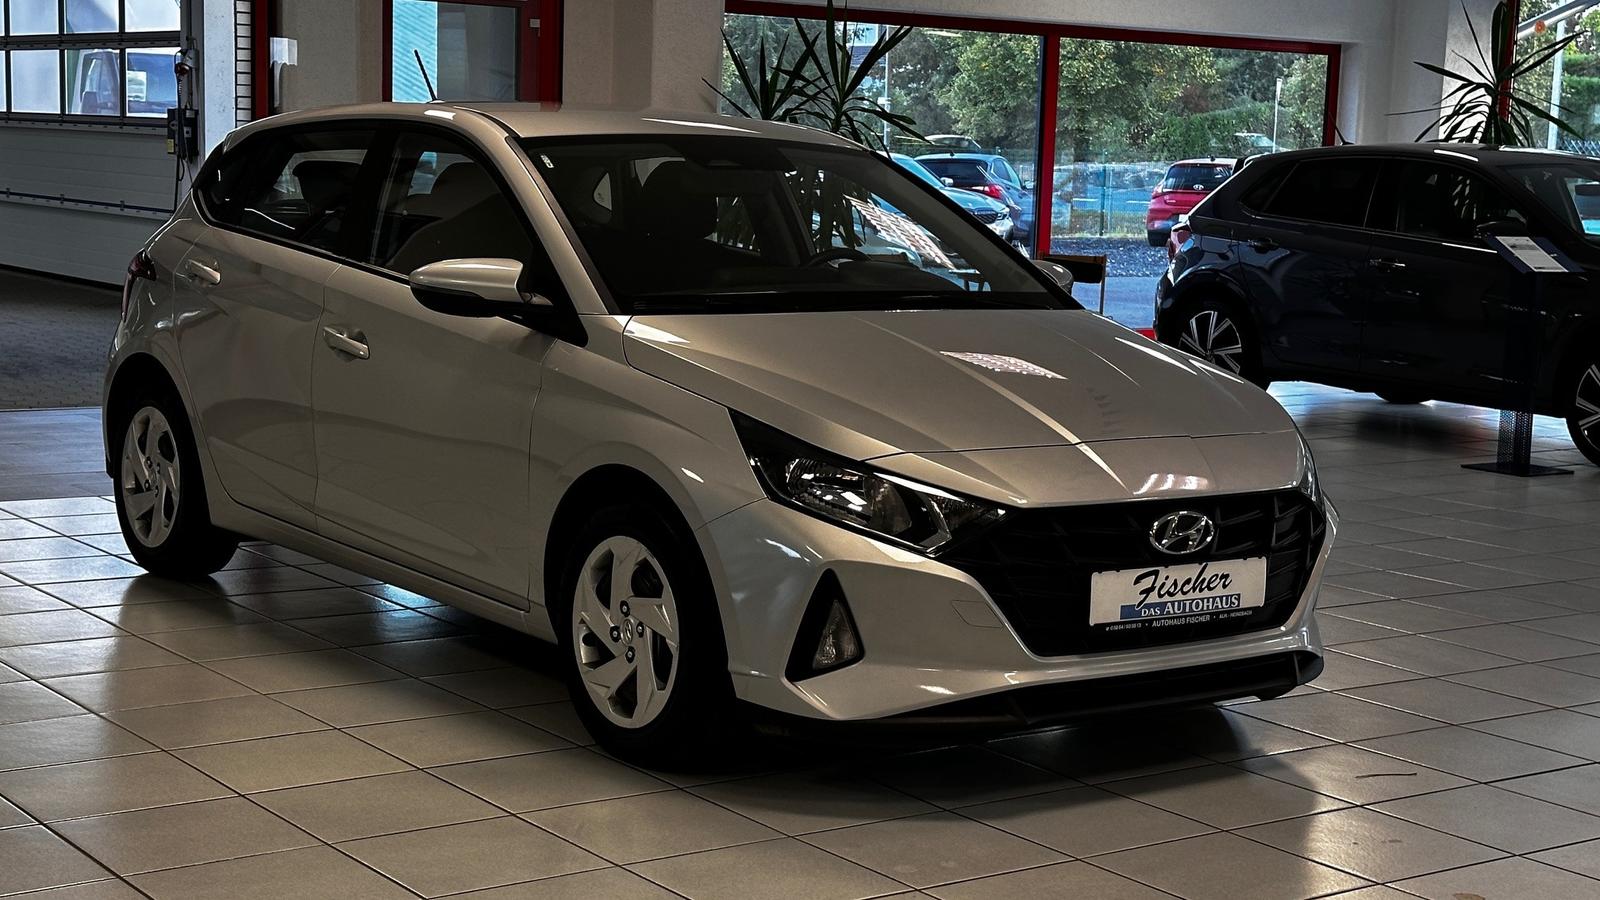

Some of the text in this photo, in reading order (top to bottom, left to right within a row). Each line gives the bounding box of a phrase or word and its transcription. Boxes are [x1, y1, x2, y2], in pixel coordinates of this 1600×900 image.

[1133, 563, 1232, 610] Fischer
[1141, 595, 1239, 617] DAS AUTOHAUS
[1152, 616, 1186, 627] AUTOHAUS
[1186, 614, 1210, 624] FISCHER
